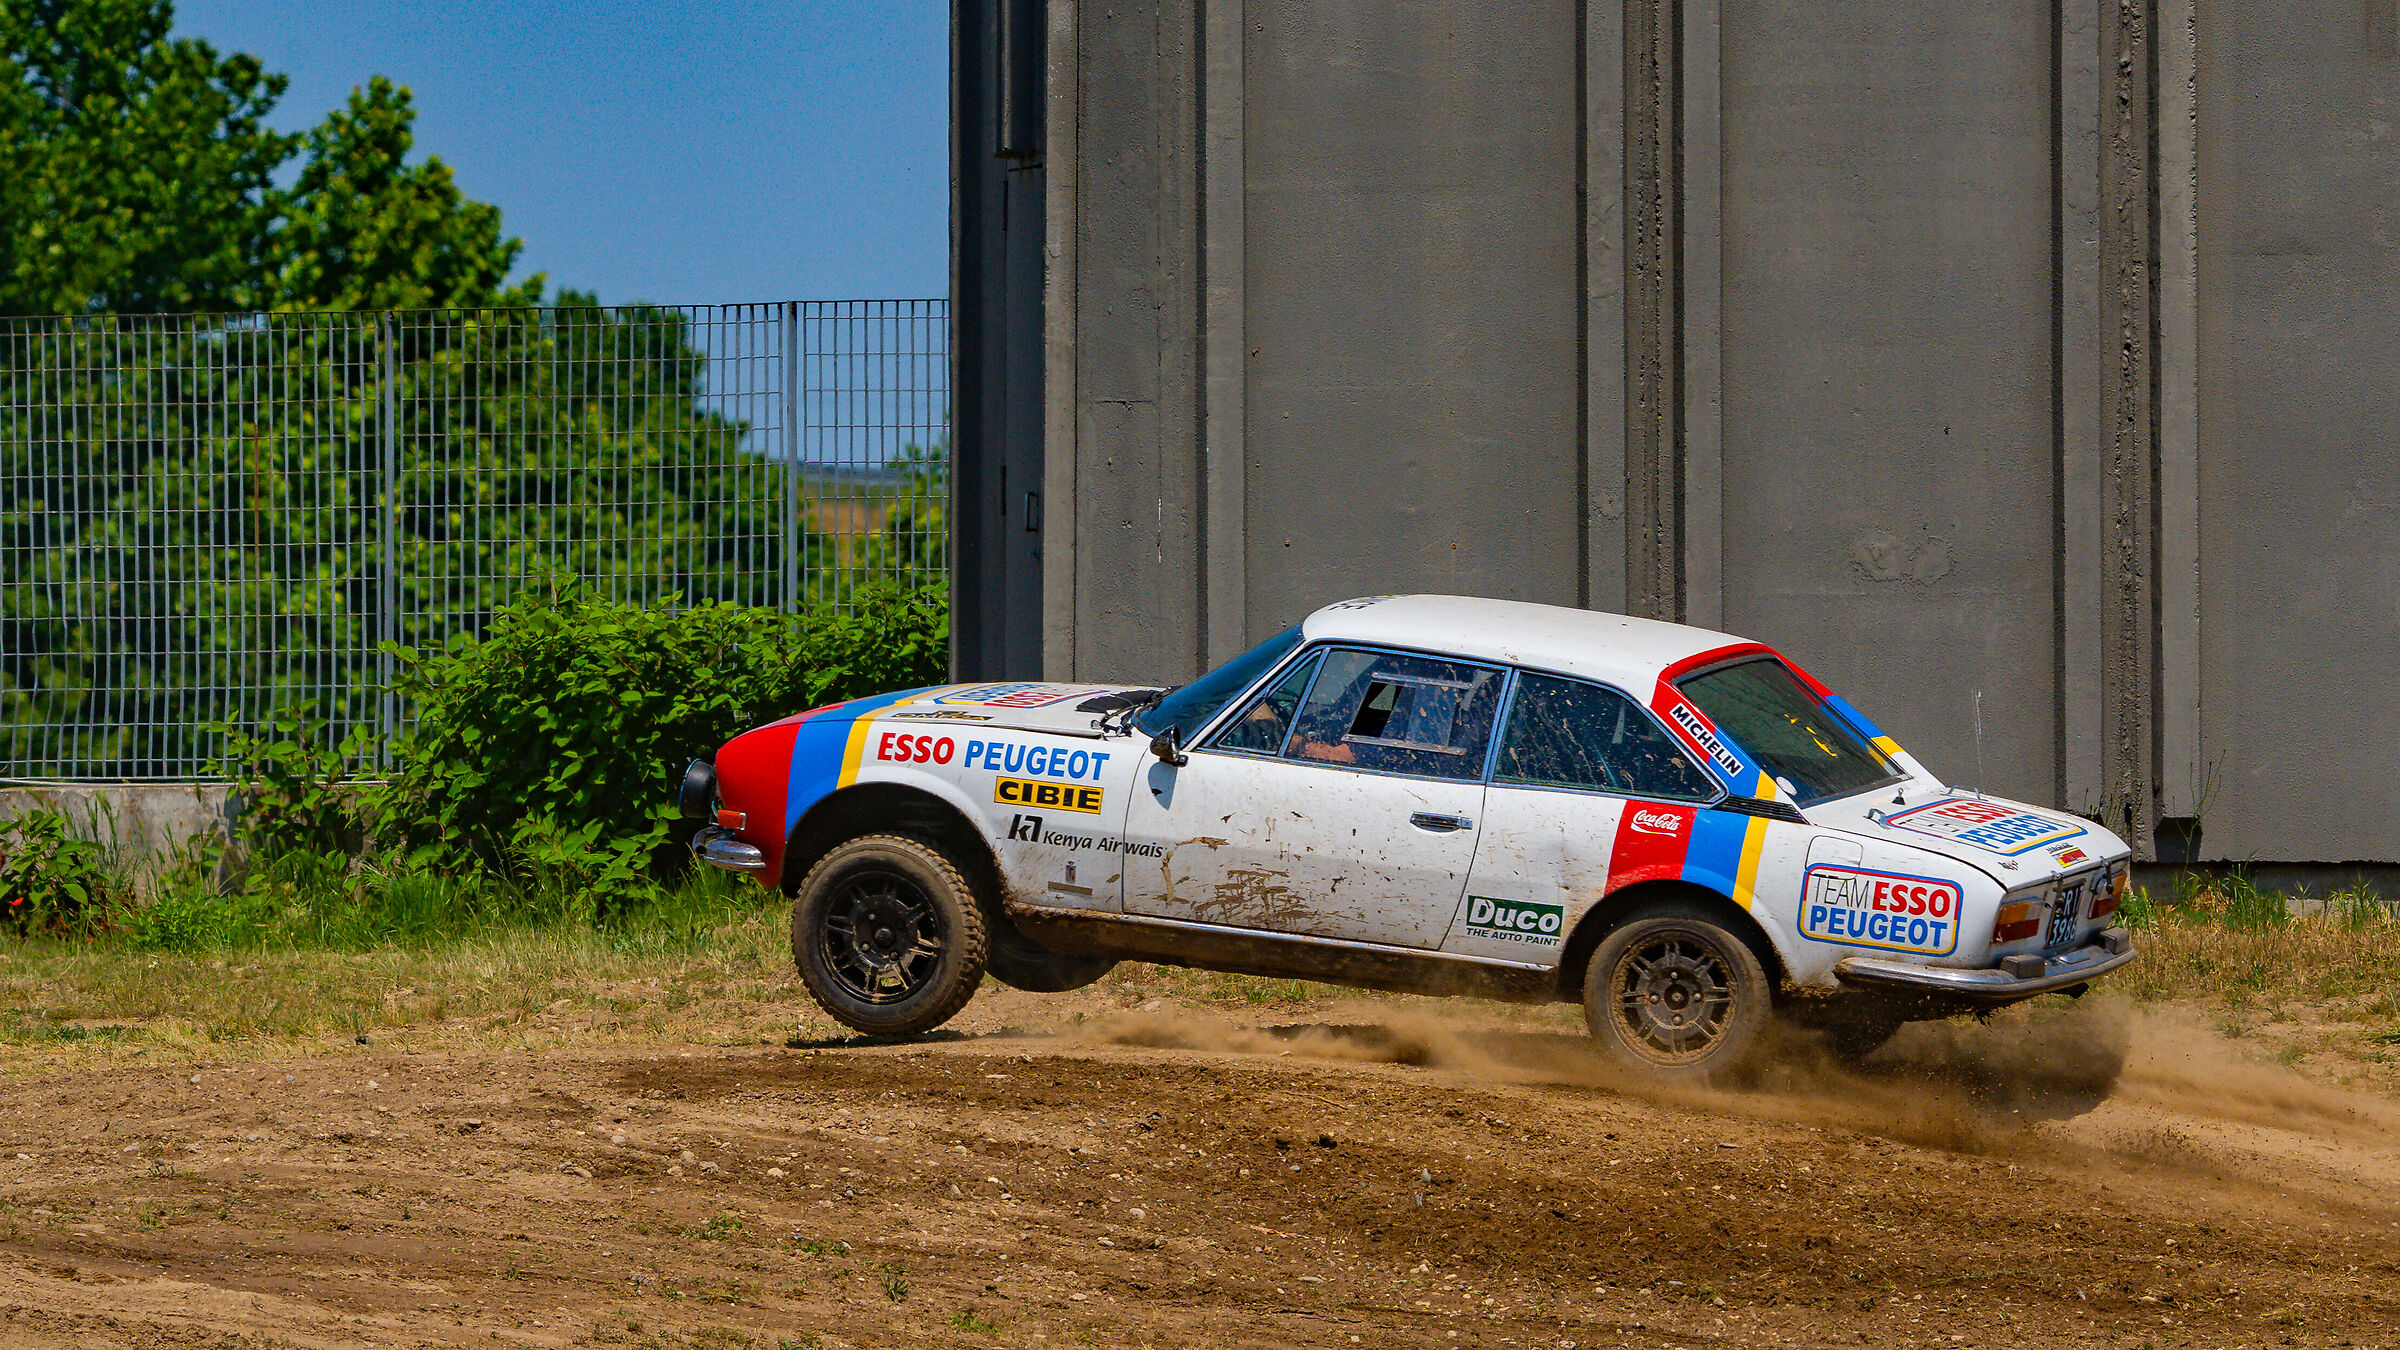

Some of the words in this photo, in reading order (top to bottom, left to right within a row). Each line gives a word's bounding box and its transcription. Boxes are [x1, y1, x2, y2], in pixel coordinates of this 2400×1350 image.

[877, 732, 955, 765] ESSO
[964, 740, 1110, 780] PEUGEOT
[1672, 705, 1742, 775] MICHELIN
[1932, 802, 2017, 824] ESSO
[1043, 830, 1093, 851] Kenya
[1955, 815, 2069, 849] PEUGEOT
[1813, 876, 1870, 909] TEAM
[1872, 880, 1950, 918] ESSO
[1469, 898, 1560, 933] Duco
[1809, 906, 1948, 948] PEUGEOT
[1466, 928, 1489, 938] THE
[1491, 932, 1522, 942] AUTO
[1525, 935, 1560, 946] PAINT
